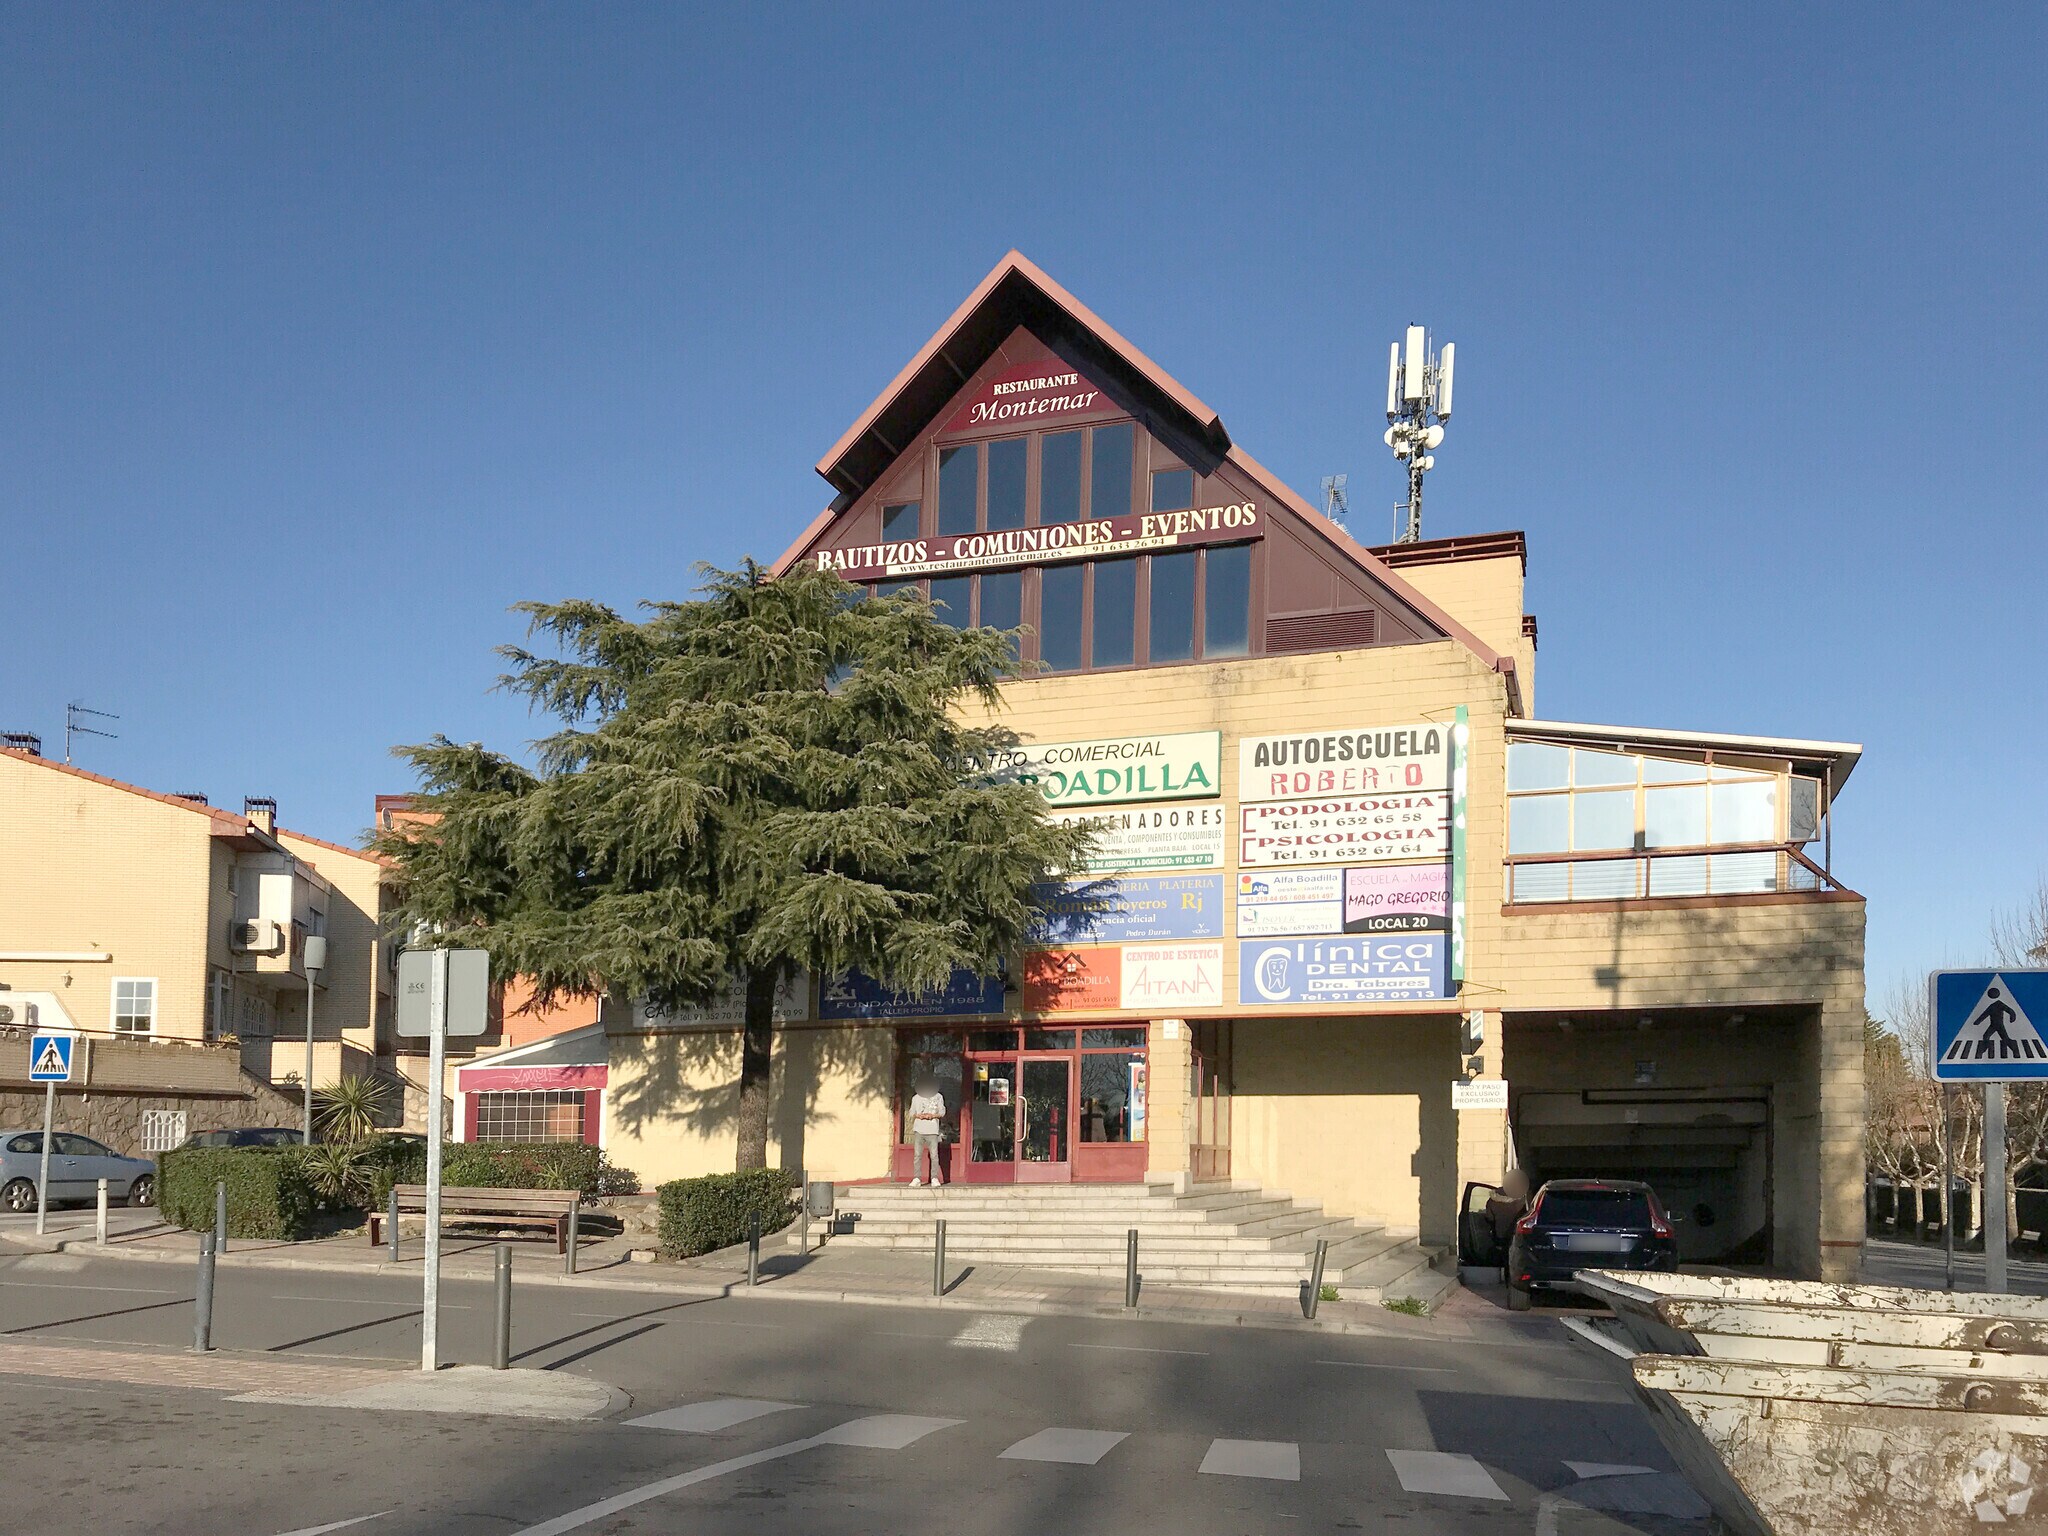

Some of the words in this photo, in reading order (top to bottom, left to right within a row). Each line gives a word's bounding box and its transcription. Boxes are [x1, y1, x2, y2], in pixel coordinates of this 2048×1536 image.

[993, 373, 1078, 395] RESTAURANTE
[969, 391, 1098, 423] Montemar
[817, 541, 928, 572] BAUTIZOS
[953, 520, 1113, 560] COMUNIONES
[1140, 502, 1257, 538] EVENTOS
[900, 549, 1063, 573] www.restaurantemontemar.es
[1109, 541, 1130, 551] 633
[1134, 539, 1148, 548] 26
[1151, 537, 1165, 545] 94
[1044, 741, 1166, 764] COMERCIAL
[1254, 729, 1440, 767] AUTOESCUELA
[1259, 797, 1435, 817] PODOLOGIA
[1271, 820, 1303, 830] Tel.
[1309, 819, 1328, 828] 91
[1336, 817, 1367, 826] 632
[1374, 814, 1394, 824] 65
[1402, 813, 1422, 822] 58
[1127, 832, 1172, 844] COMPONENTES
[1178, 829, 1222, 841] CONSUMIBLES
[1258, 828, 1436, 847] PSICOLOGIA
[1192, 843, 1210, 851] LOCAL
[1271, 850, 1303, 860] Tel.
[1309, 849, 1328, 858] 91
[1336, 847, 1367, 857] 632
[1374, 845, 1394, 855] 67
[1401, 844, 1421, 853] 64
[1159, 879, 1215, 890] PLATERIA
[1274, 876, 1293, 884] Alfa
[1296, 874, 1338, 883] Boadilla
[1351, 874, 1399, 885] ESCUELA
[1410, 872, 1448, 882] MAGIA
[1181, 892, 1203, 913] Rj
[1349, 894, 1383, 906] MAGO
[1388, 890, 1450, 906] GREGORIO
[1128, 914, 1156, 924] oficial
[1368, 917, 1409, 929] LOCAL
[1412, 917, 1429, 928] 20
[1126, 952, 1160, 962] CENTRO
[1162, 951, 1174, 960] DE
[1177, 949, 1219, 960] ESTETICA
[1306, 960, 1431, 975] DENTAL
[1064, 975, 1111, 986] BOADILLA
[1311, 980, 1348, 989] Dra.
[1354, 978, 1426, 988] Tabares
[1300, 992, 1326, 1001] Tel.
[1355, 992, 1385, 1000] 632
[1390, 991, 1408, 999] 09
[1416, 990, 1435, 998] 13
[879, 1007, 909, 1015] TALLER
[911, 1006, 944, 1014] PROPIO
